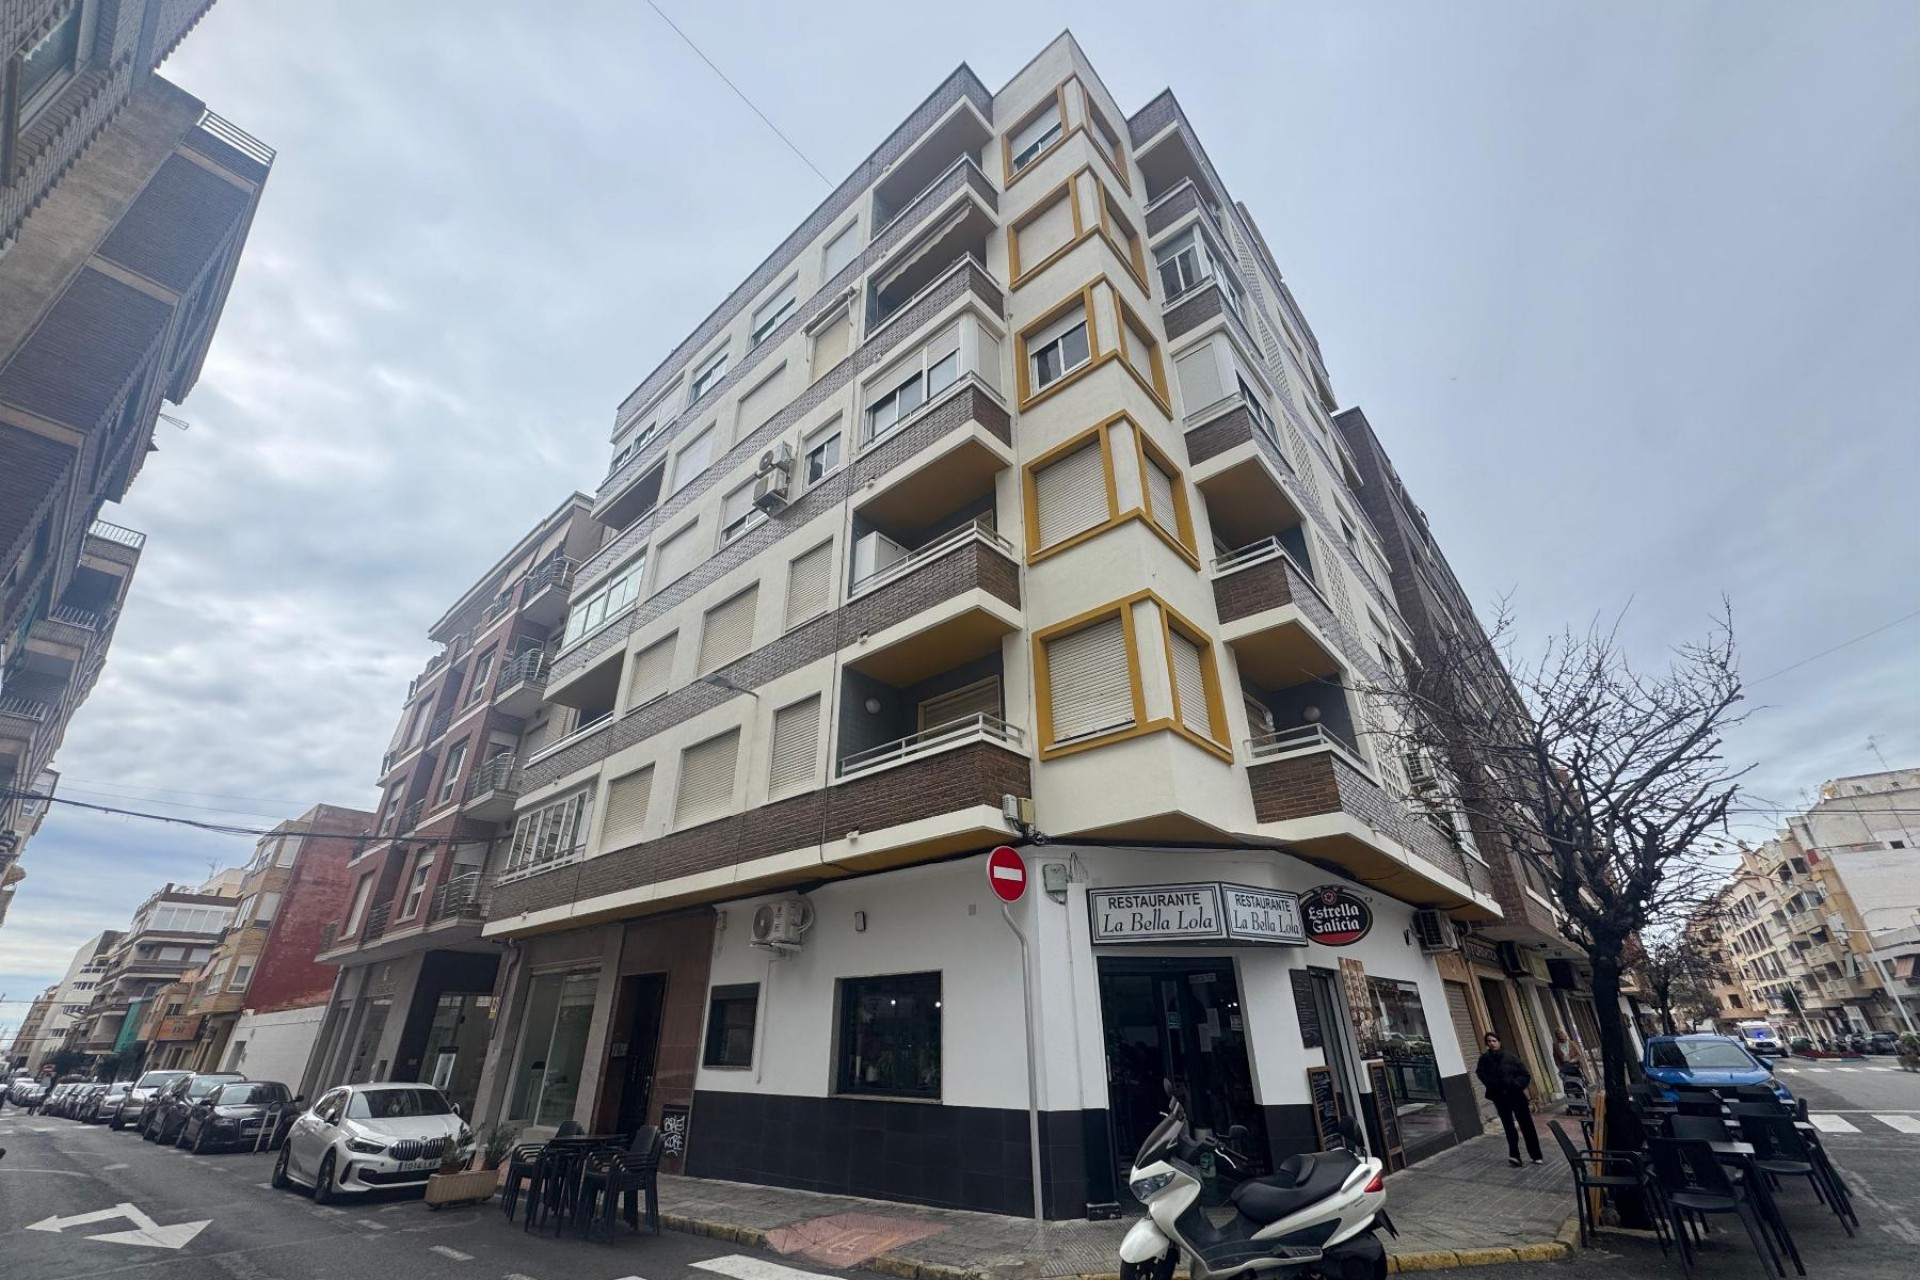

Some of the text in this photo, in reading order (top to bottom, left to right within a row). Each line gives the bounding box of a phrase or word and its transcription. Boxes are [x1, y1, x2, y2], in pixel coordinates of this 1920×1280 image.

[1108, 892, 1201, 910] RESTAURANTE
[1234, 893, 1292, 912] RESTAURANTE
[1102, 906, 1214, 933] La Bella Lola
[1308, 903, 1360, 920] Estrella
[1233, 910, 1300, 935] La Bella Lola
[1312, 916, 1360, 933] Galicia
